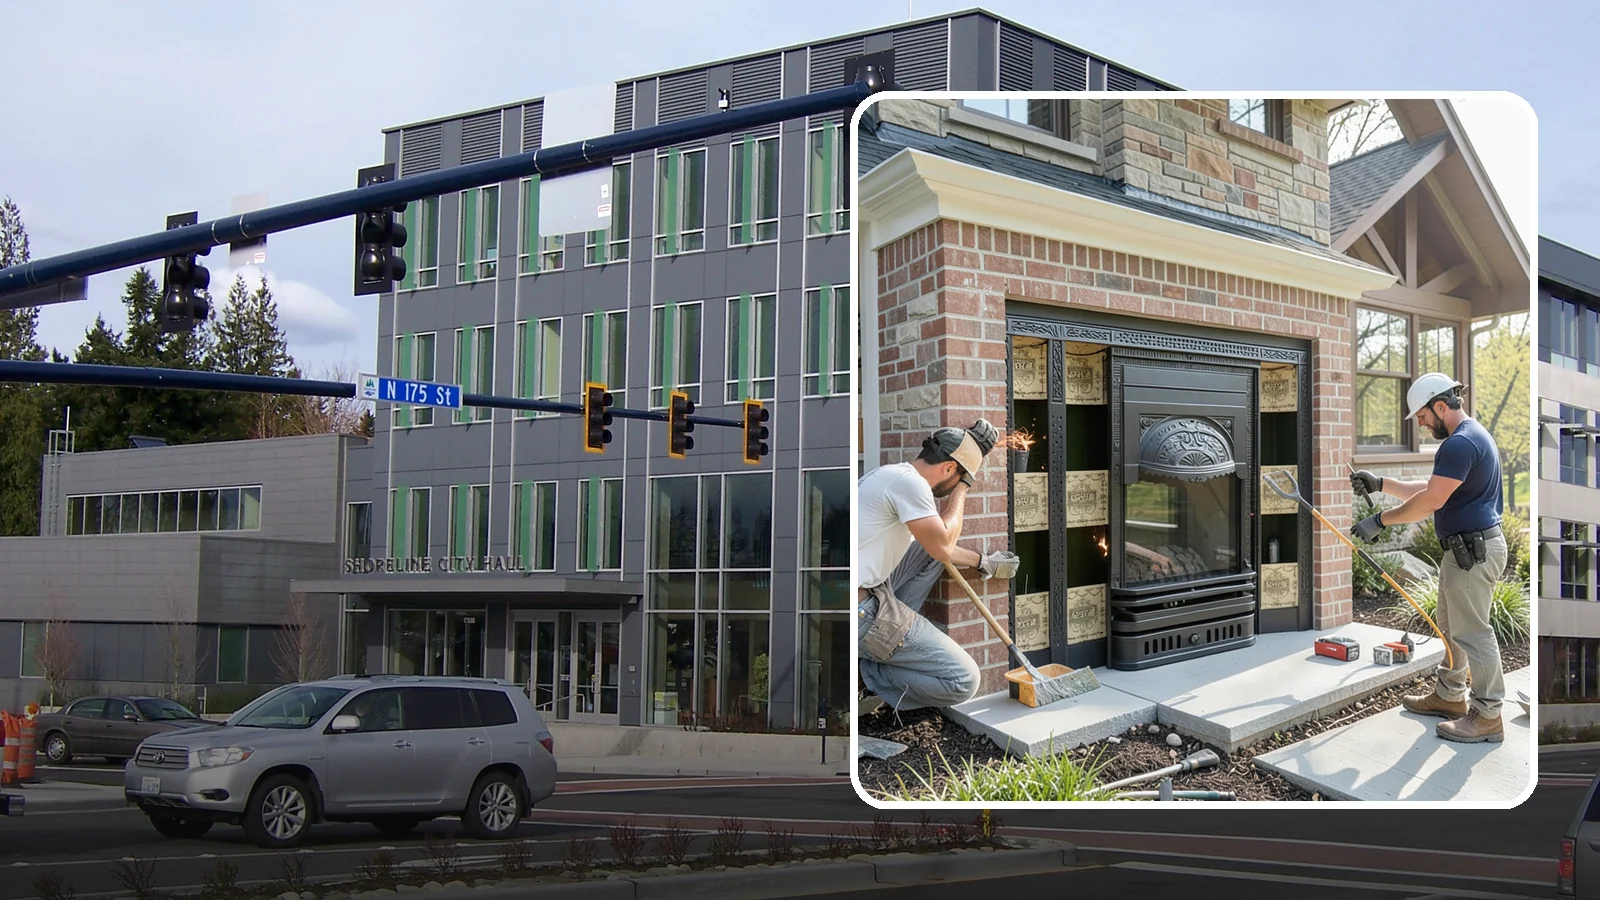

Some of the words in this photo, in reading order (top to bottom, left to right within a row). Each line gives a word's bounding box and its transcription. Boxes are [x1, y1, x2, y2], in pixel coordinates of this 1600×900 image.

[387, 380, 396, 400] N
[405, 383, 427, 403] 175
[436, 386, 451, 406] St
[344, 557, 432, 574] SHORELINE
[438, 556, 476, 573] CITY
[484, 555, 525, 573] HALL
